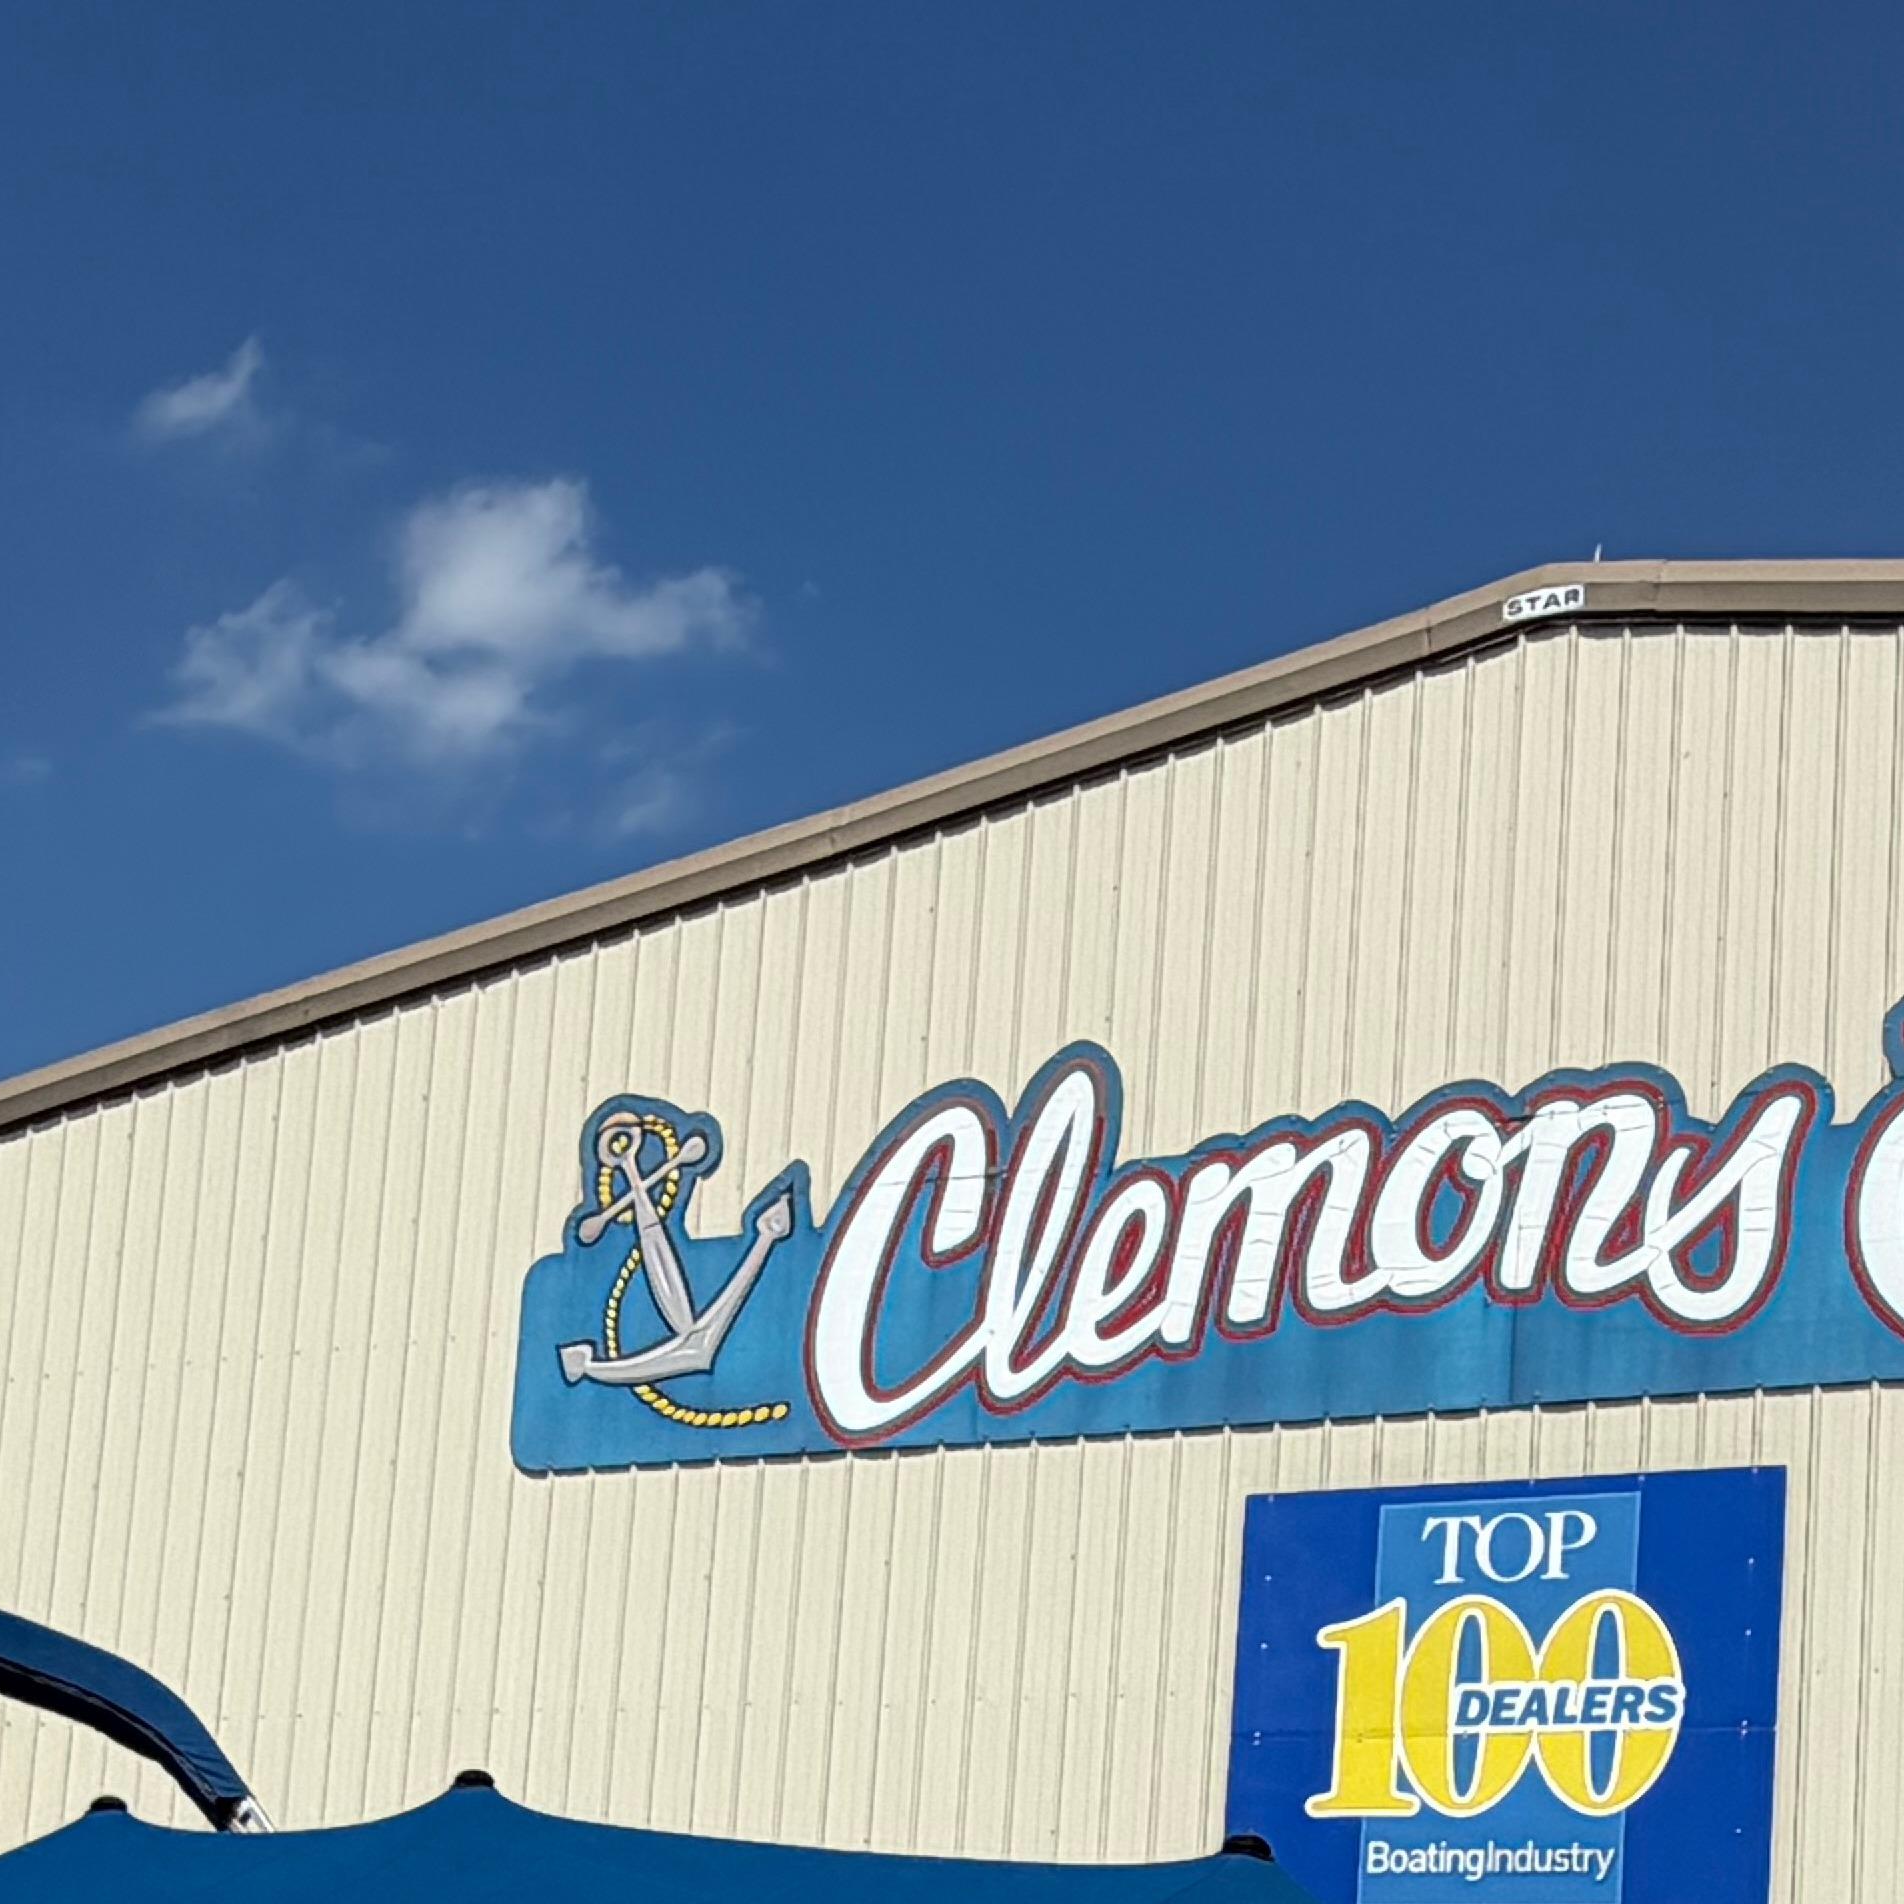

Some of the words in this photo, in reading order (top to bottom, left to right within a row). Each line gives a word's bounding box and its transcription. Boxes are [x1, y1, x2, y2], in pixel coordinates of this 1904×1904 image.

[1507, 589, 1580, 616] STAR
[804, 1058, 1817, 1447] Clemons
[1422, 1509, 1598, 1585] TOP
[1304, 1588, 1682, 1819] 100
[1454, 1683, 1680, 1728] DEALERS
